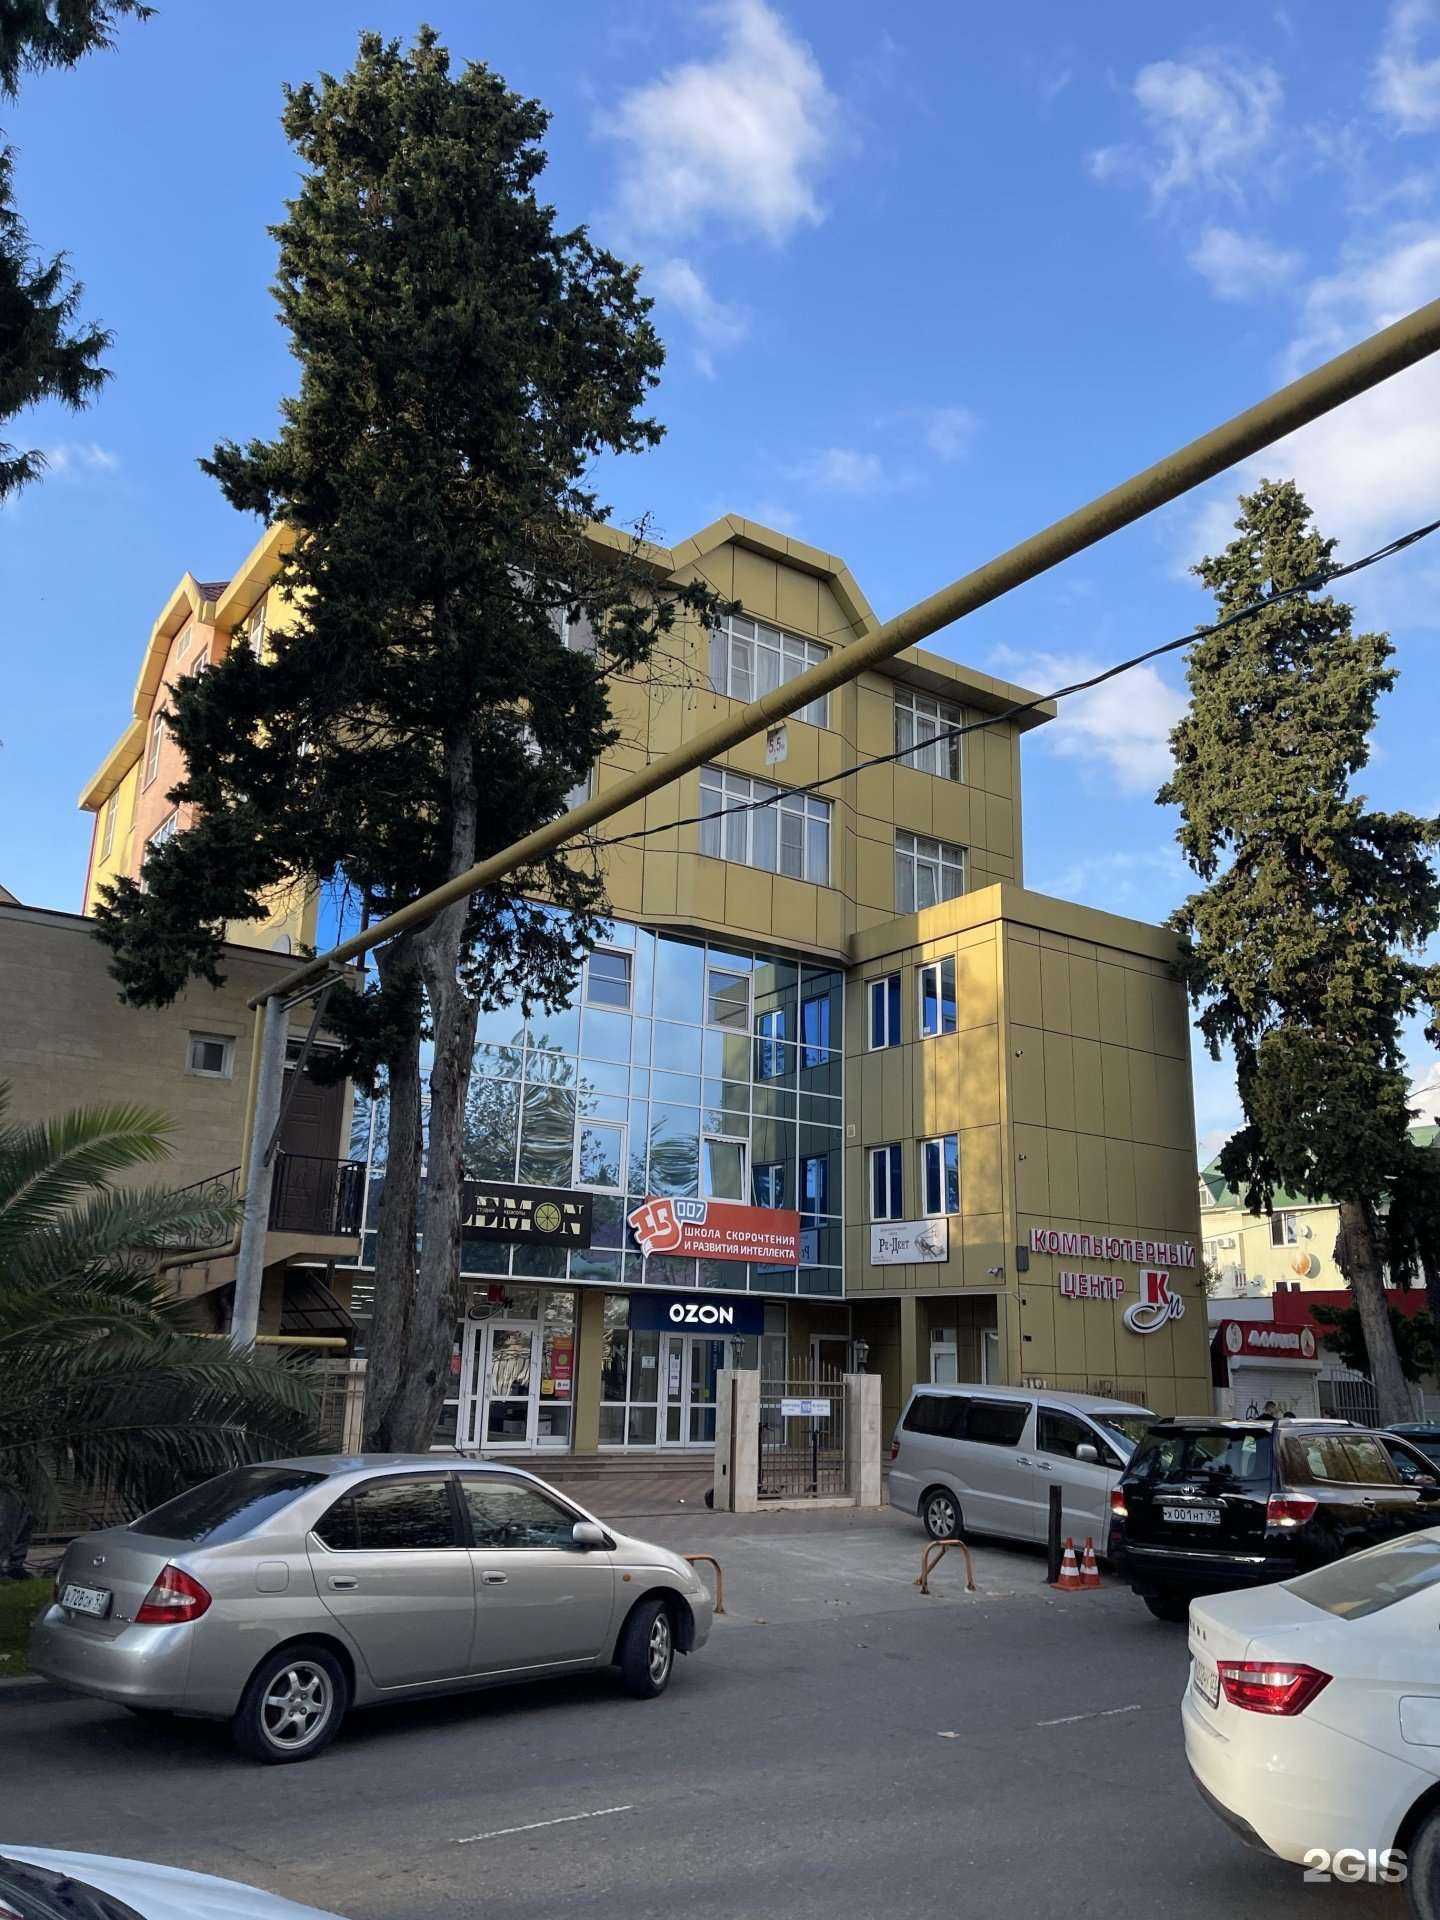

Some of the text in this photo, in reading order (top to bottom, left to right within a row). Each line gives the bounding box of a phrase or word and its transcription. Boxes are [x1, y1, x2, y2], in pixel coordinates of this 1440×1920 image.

[462, 1195, 584, 1235] EMON
[677, 1202, 704, 1218] 007
[684, 1227, 795, 1245] ШКОЛА СКОРОЧТЕНИЯ
[684, 1242, 796, 1259] И РАЗВИТИЯ ИНТЕЛЛЕКТА
[1031, 1228, 1196, 1267] КОМПЬЮТЕРНЫЙ
[1060, 1271, 1126, 1300] ЦЕНТР
[669, 1303, 733, 1324] OZON
